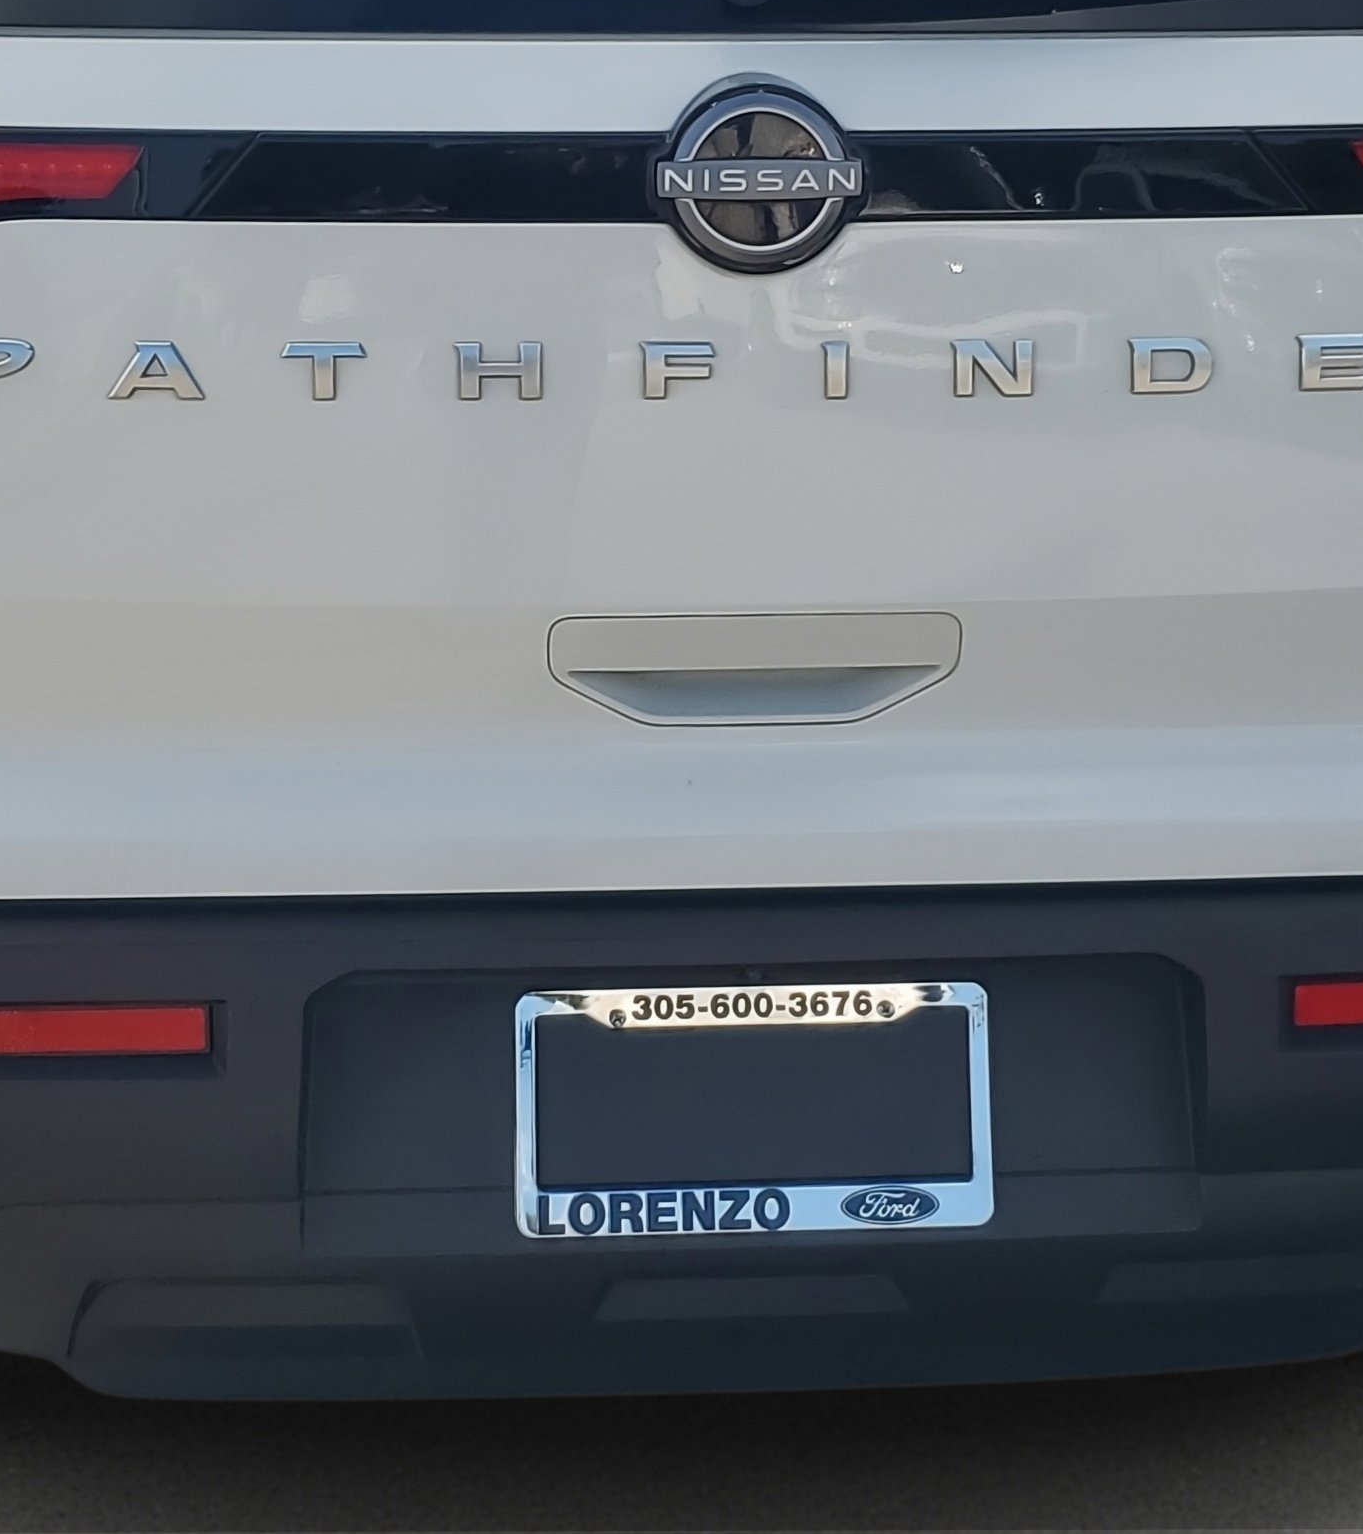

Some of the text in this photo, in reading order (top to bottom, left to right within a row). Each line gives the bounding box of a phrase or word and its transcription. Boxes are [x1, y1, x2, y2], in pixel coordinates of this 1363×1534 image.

[664, 168, 856, 192] NISSAN
[632, 990, 873, 1020] 305-600-3676
[538, 1188, 790, 1236] LORENZO
[858, 1191, 921, 1219] Ford
